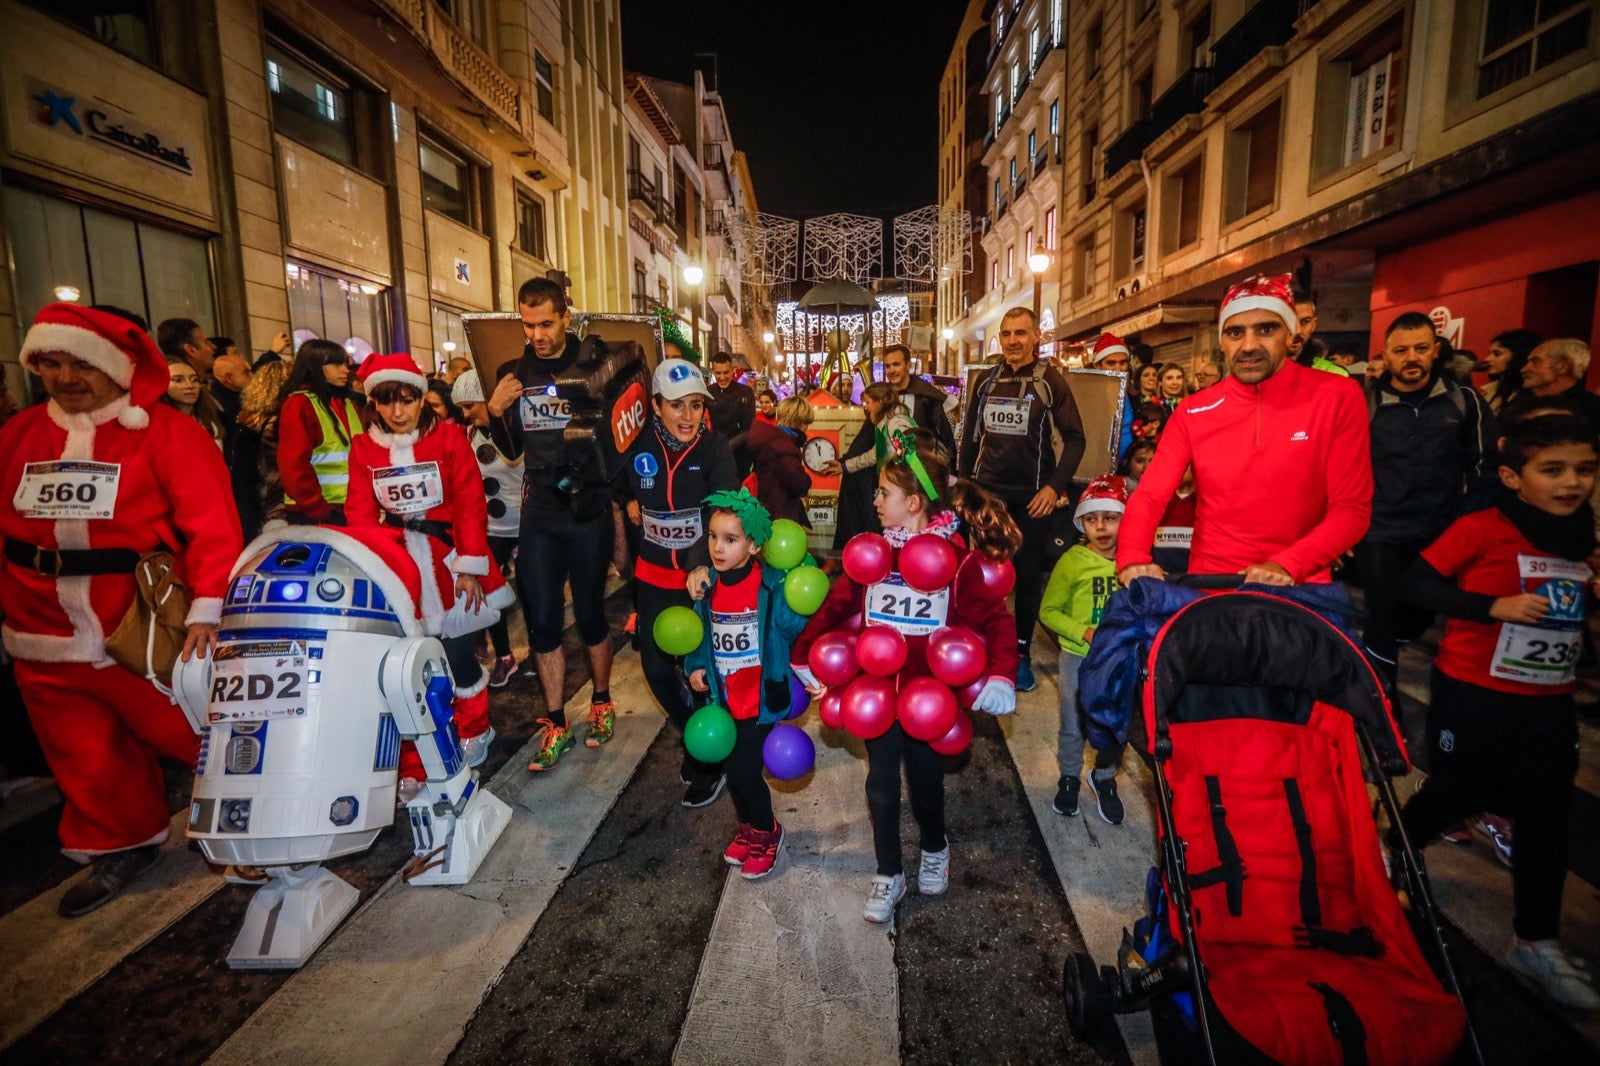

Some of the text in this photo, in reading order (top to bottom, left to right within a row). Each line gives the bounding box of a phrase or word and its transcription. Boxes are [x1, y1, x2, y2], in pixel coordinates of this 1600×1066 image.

[84, 109, 193, 171] CaixaBank
[675, 367, 683, 379] 1
[529, 402, 571, 418] 1076
[990, 411, 1023, 424] 1093
[617, 399, 645, 443] rtve
[641, 457, 650, 473] 1
[37, 483, 97, 503] 560
[388, 481, 428, 501] 561
[650, 524, 696, 539] 1025
[1529, 561, 1547, 572] 30
[881, 594, 932, 619] 212
[713, 632, 750, 652] 366
[211, 672, 301, 703] R2D2
